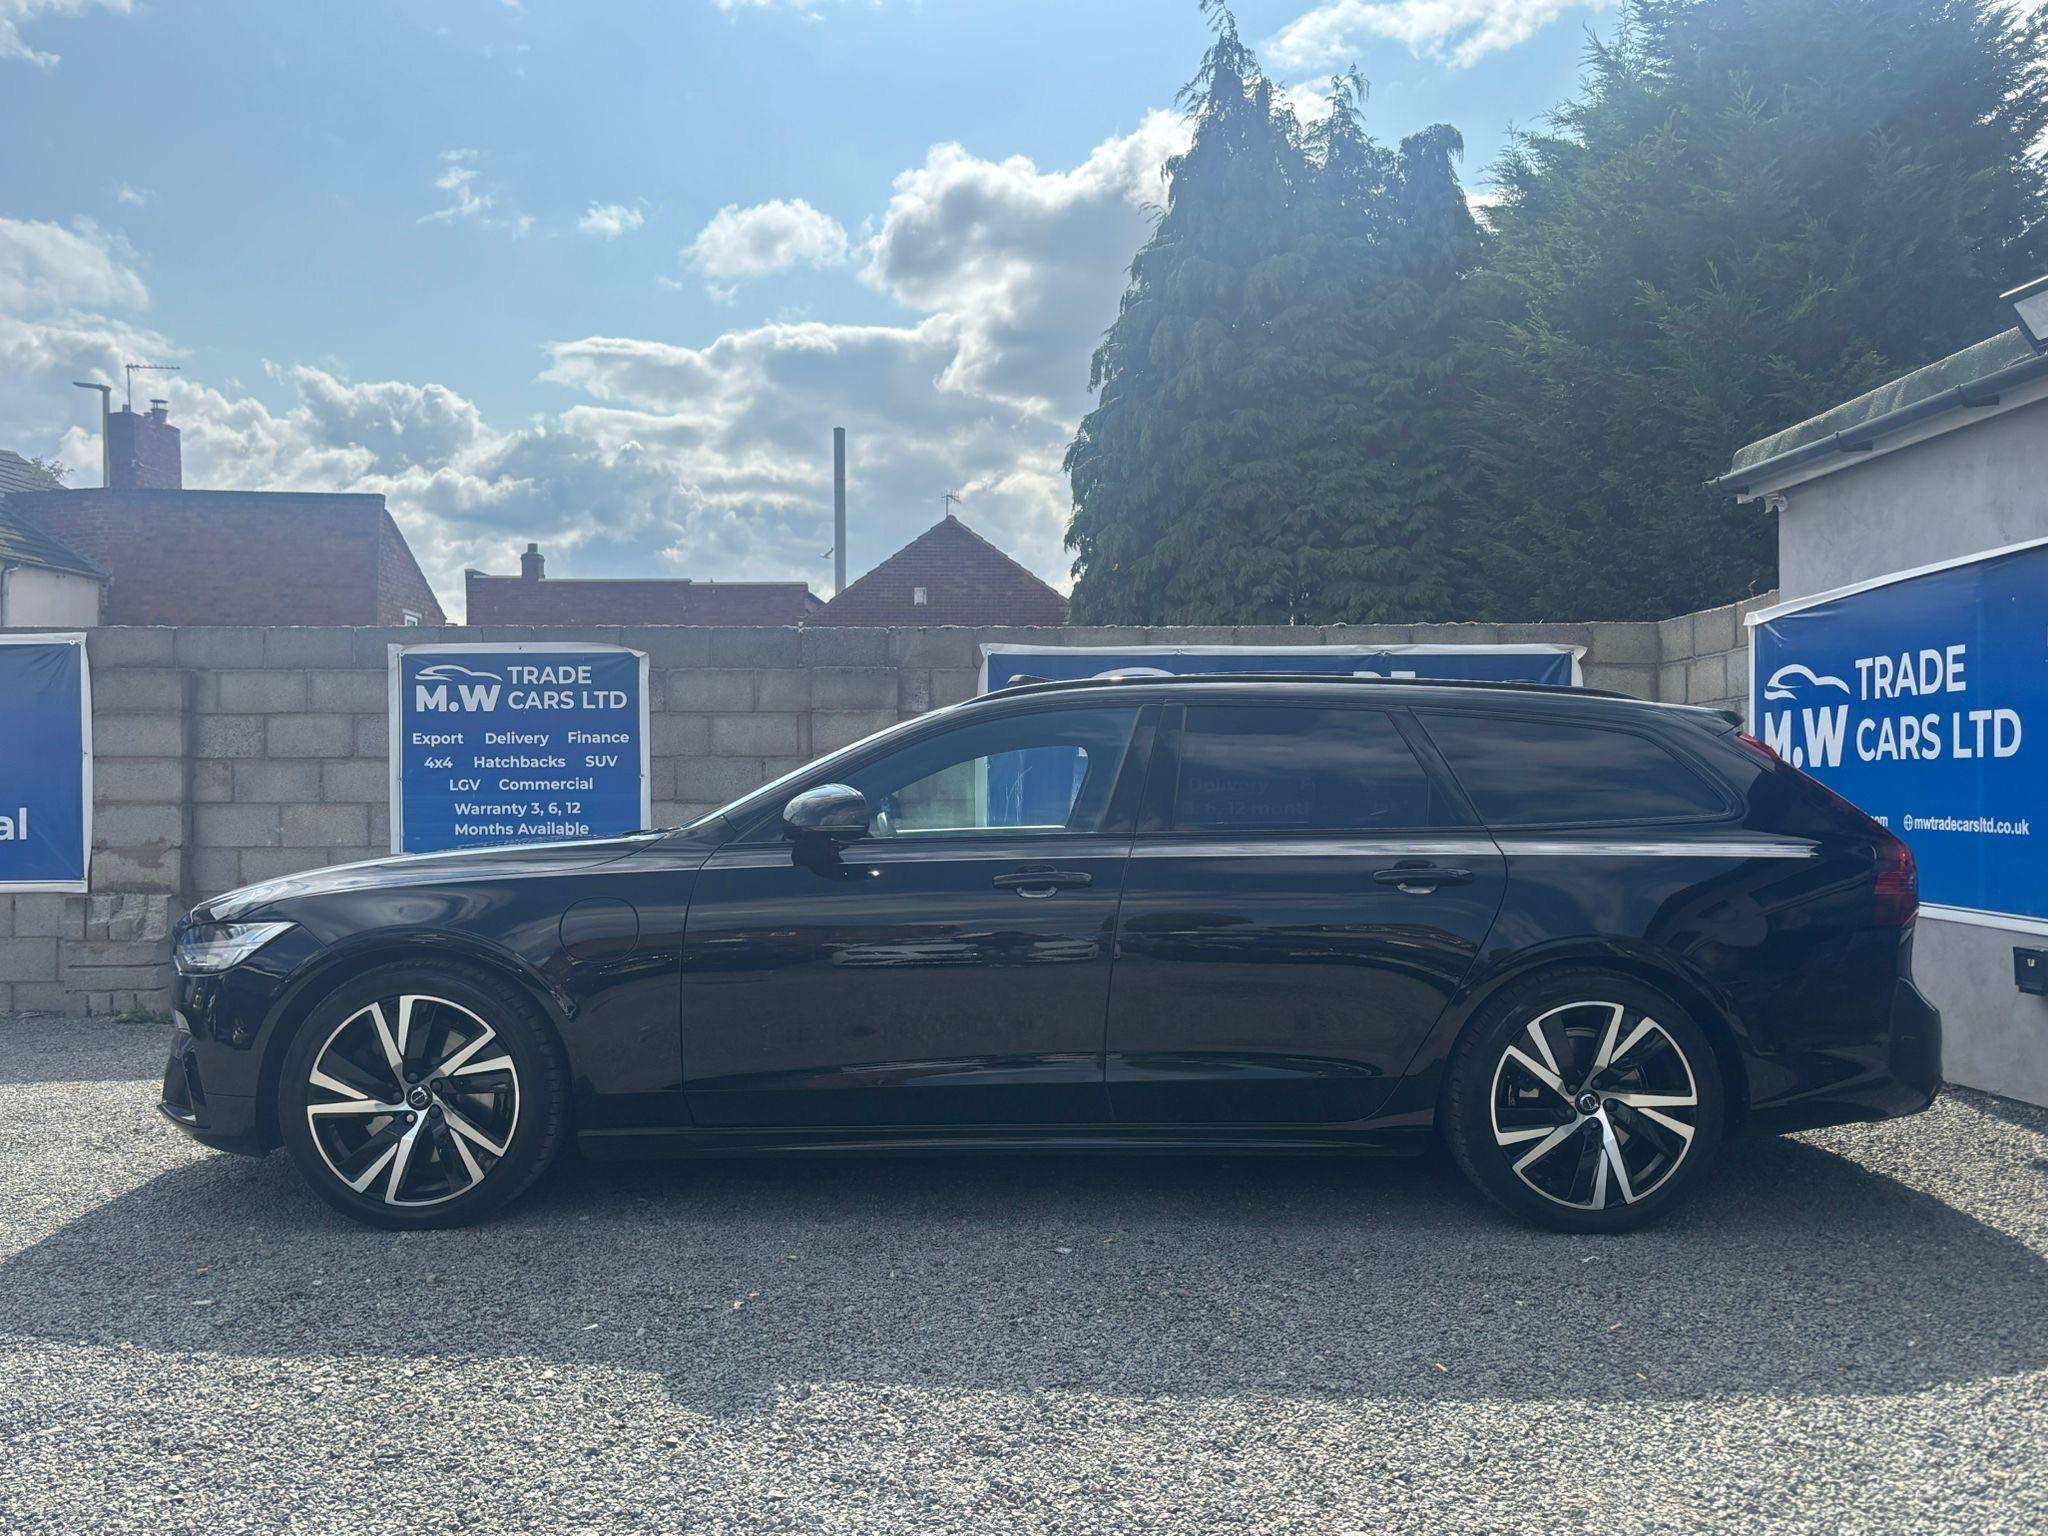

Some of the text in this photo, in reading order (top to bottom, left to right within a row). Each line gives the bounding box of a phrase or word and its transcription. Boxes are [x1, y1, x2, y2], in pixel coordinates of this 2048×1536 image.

[506, 665, 592, 685] TRADE
[1854, 644, 1967, 701] TRADE
[415, 684, 502, 713] M.W
[507, 690, 628, 710] CARS LTD
[412, 730, 630, 748] Export Delivery Finance
[1764, 704, 1849, 769] M.W
[1856, 708, 2022, 762] CARS LTD
[424, 755, 619, 769] 4x4 Hatchbacks SUV
[449, 776, 594, 791] LGV Commercial
[454, 801, 582, 818] Warranty 3, 6, 12
[454, 821, 590, 837] Months Available
[1914, 815, 2030, 836] mwtradecarsltd.co.uk
